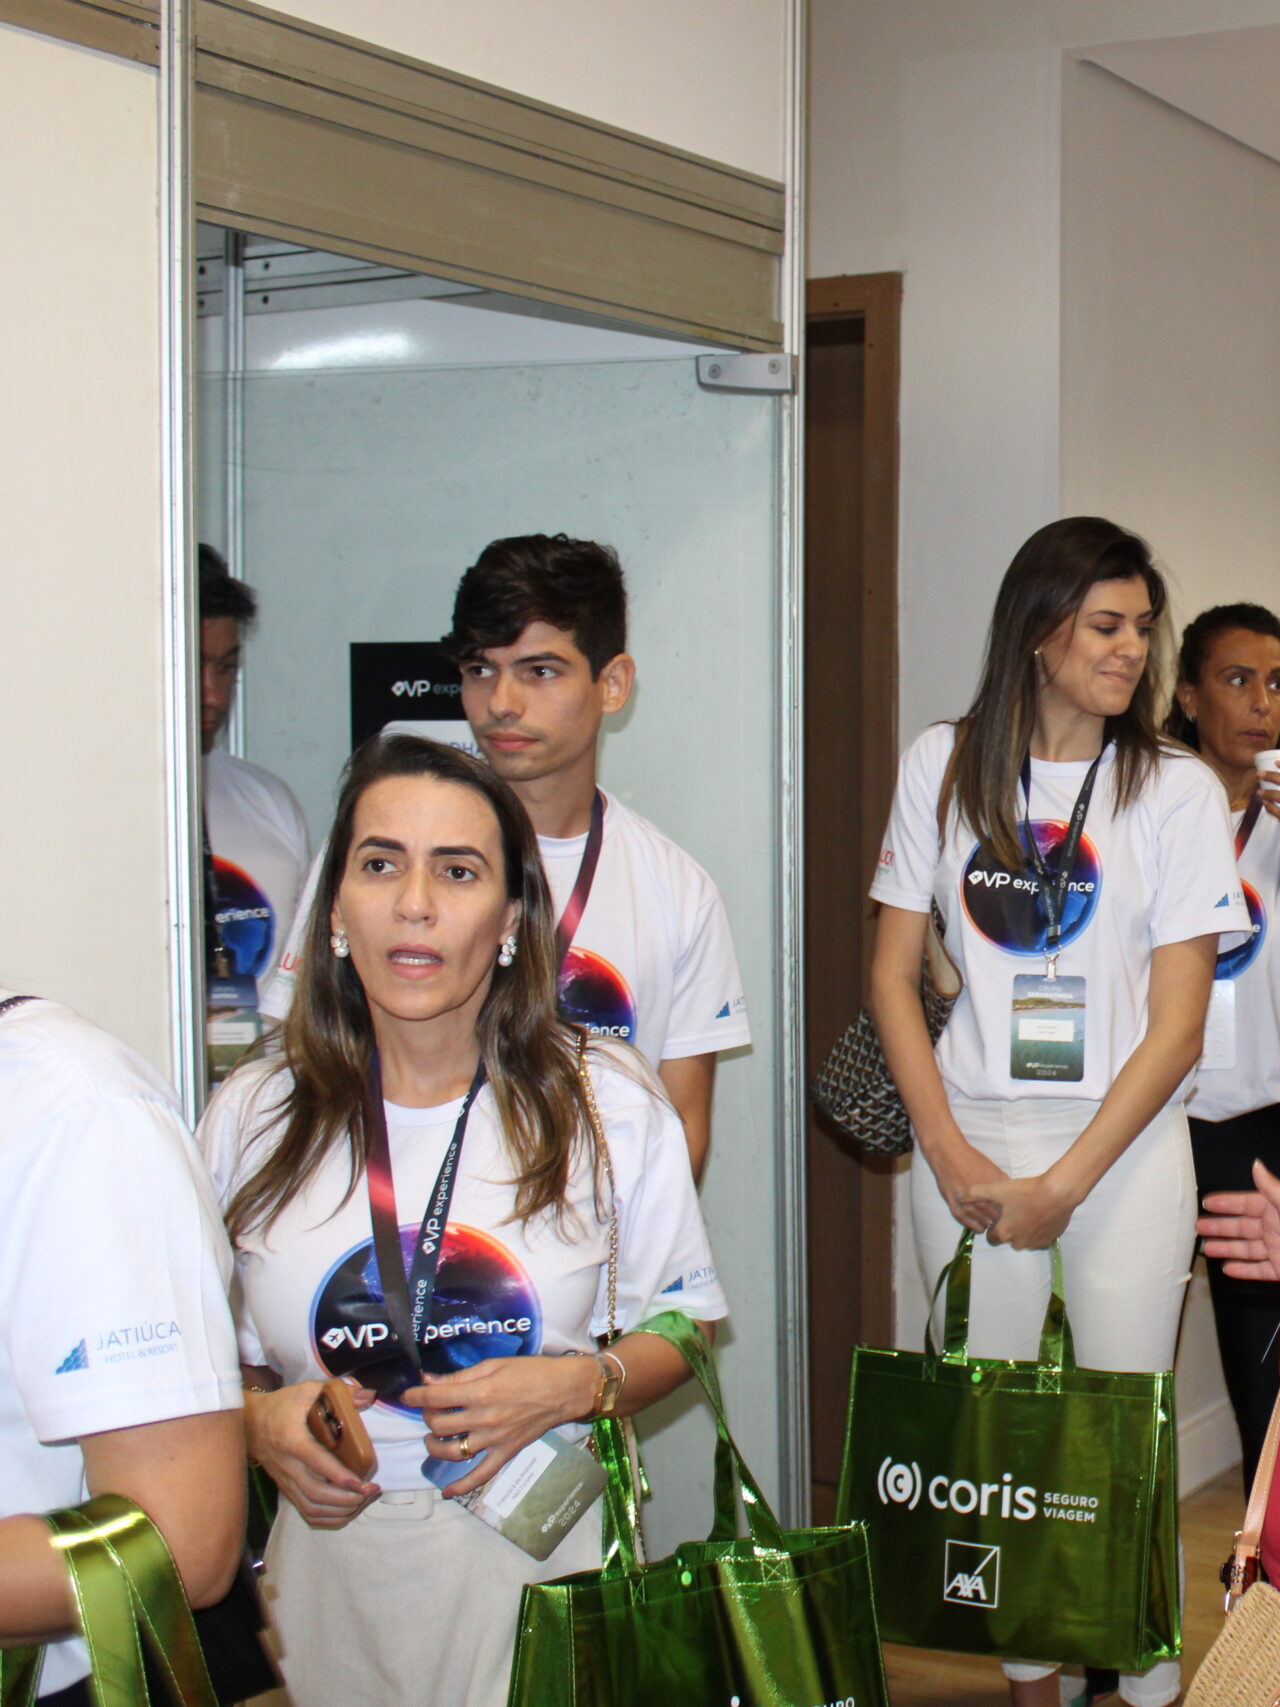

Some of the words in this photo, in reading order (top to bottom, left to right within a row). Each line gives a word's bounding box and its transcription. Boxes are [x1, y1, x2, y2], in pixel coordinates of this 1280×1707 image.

[433, 683, 462, 698] exp
[983, 870, 1011, 889] VP
[423, 1218, 441, 1244] VP
[433, 1142, 458, 1217] experience
[97, 1321, 182, 1351] JATIÚCA
[344, 1322, 389, 1349] VP
[928, 1472, 1038, 1521] coris
[1043, 1492, 1099, 1509] SEGURO
[1043, 1507, 1096, 1524] VIAGEM
[947, 1572, 988, 1601] AXA
